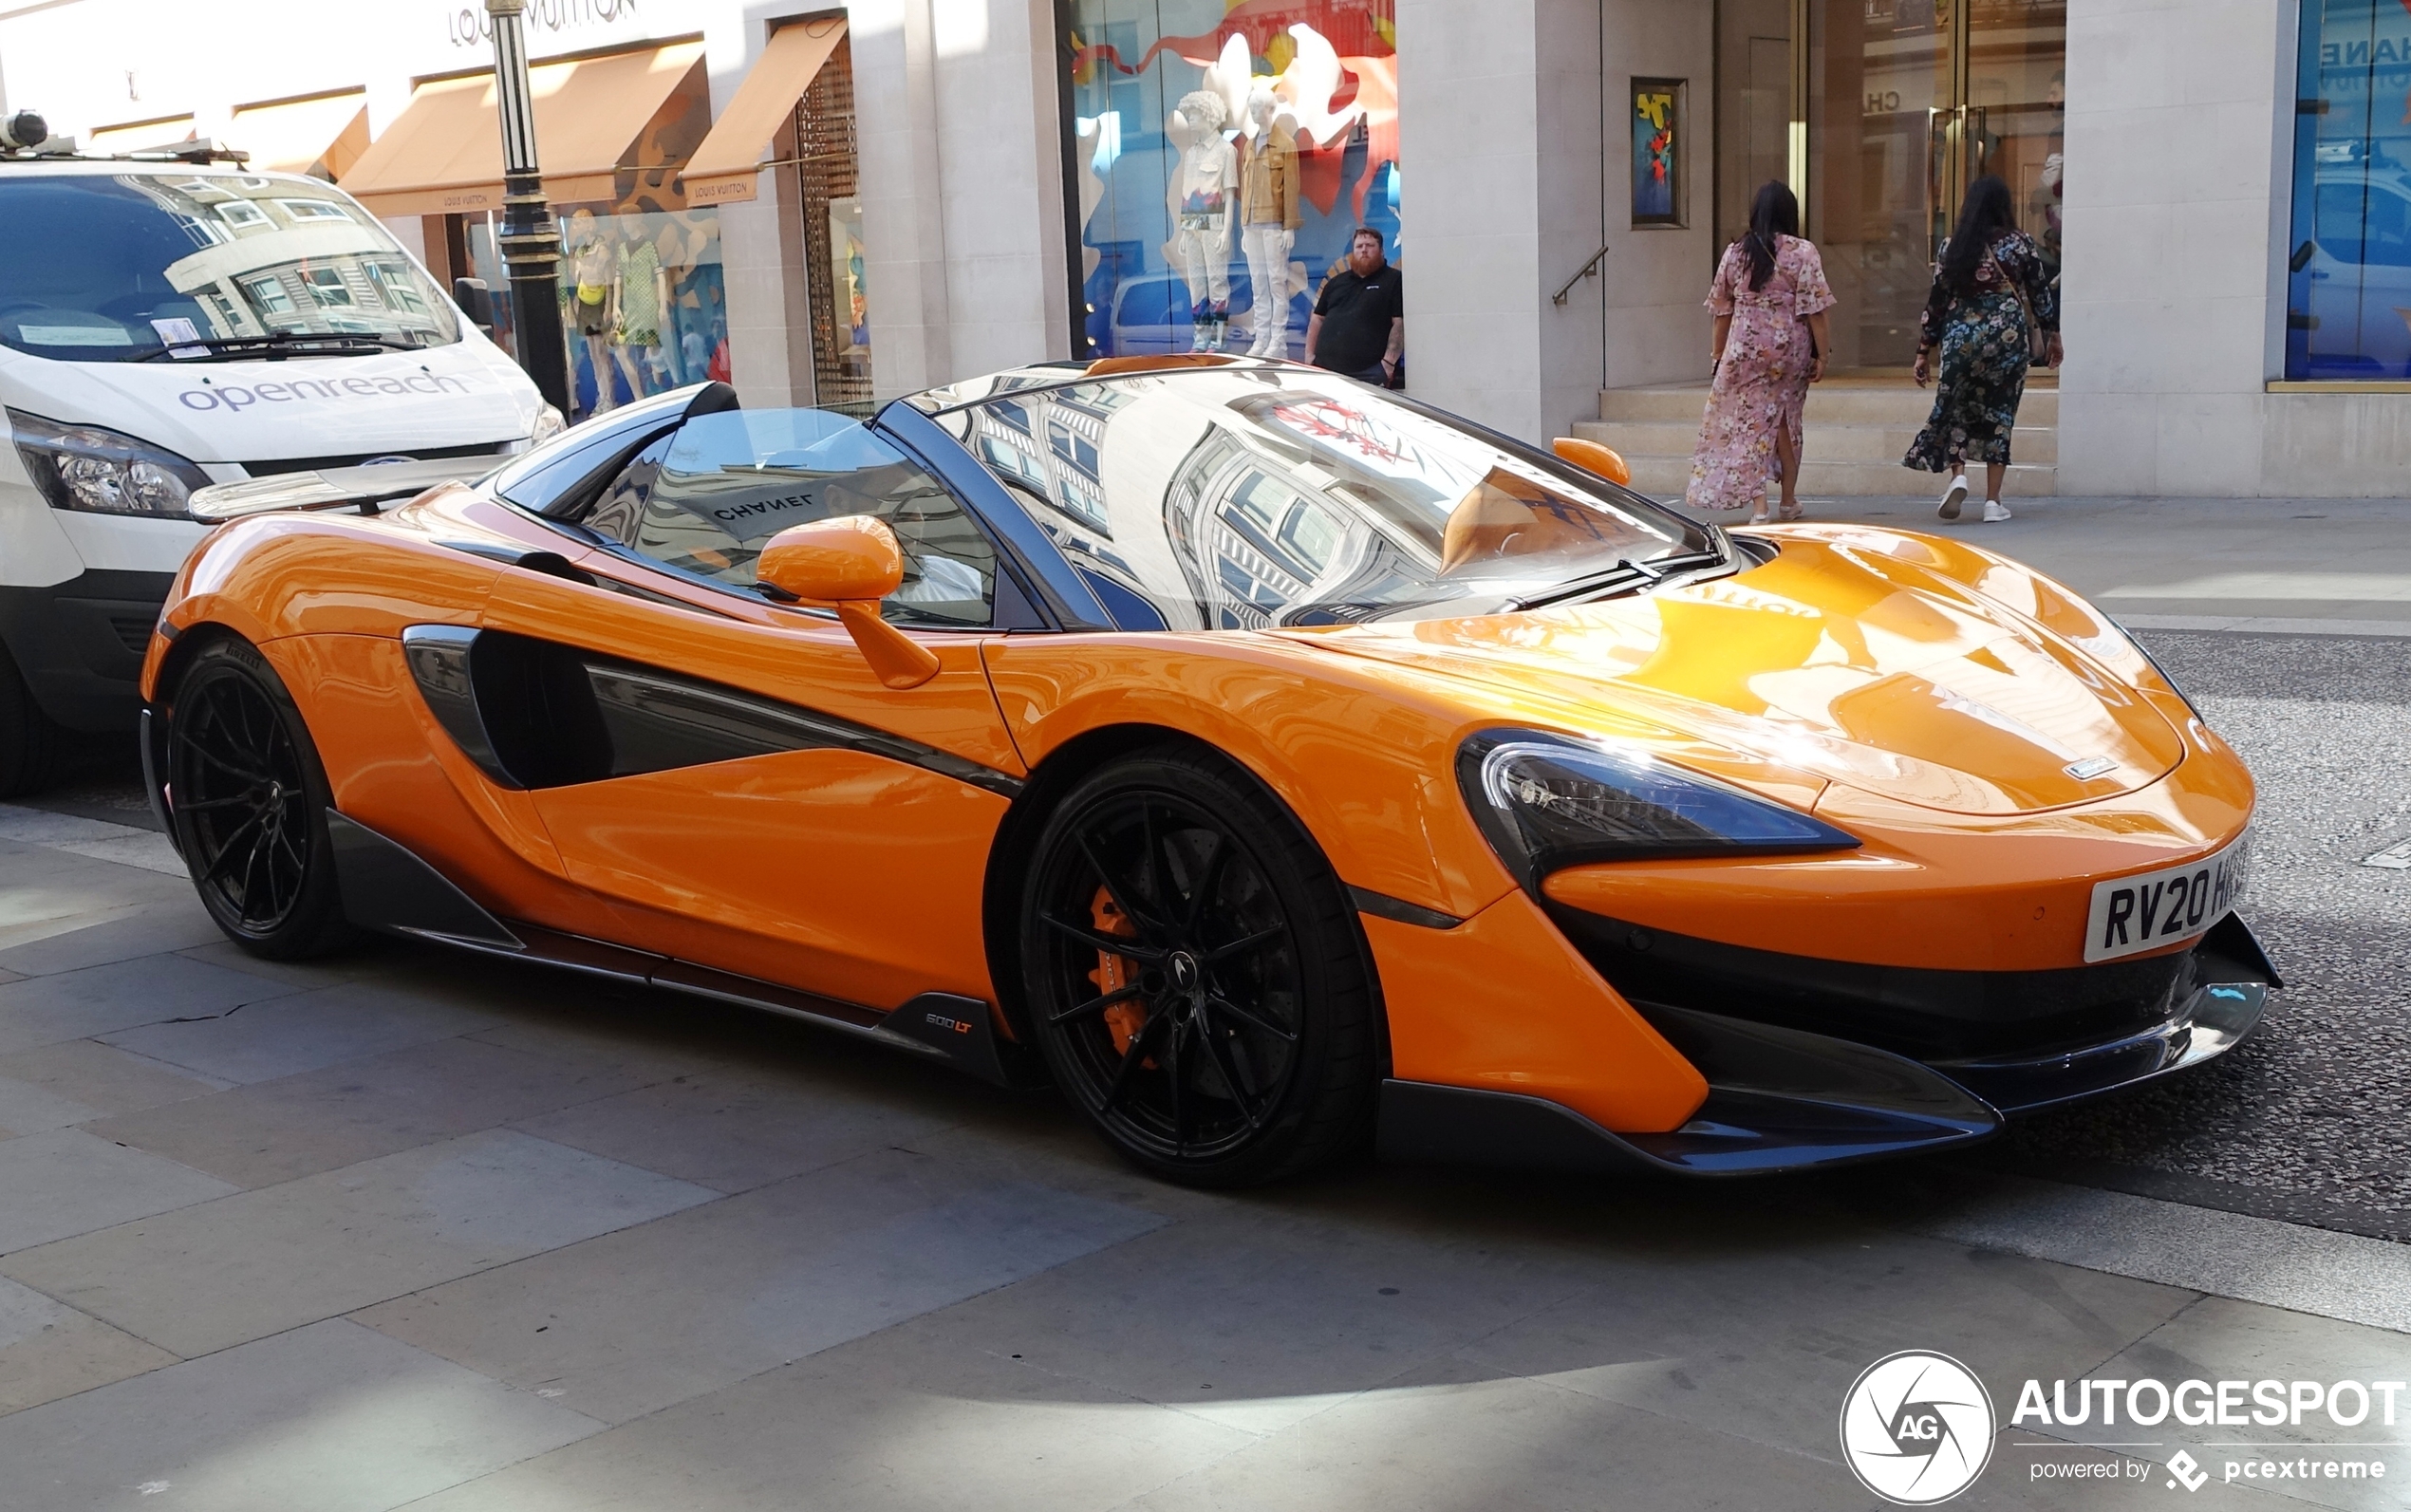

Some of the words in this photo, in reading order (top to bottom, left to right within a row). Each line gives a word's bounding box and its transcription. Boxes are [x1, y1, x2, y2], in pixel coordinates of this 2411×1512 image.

[694, 185, 716, 197] LOUIS
[717, 181, 747, 196] VUITTON
[178, 372, 471, 412] openreach
[2103, 868, 2210, 949] RV20
